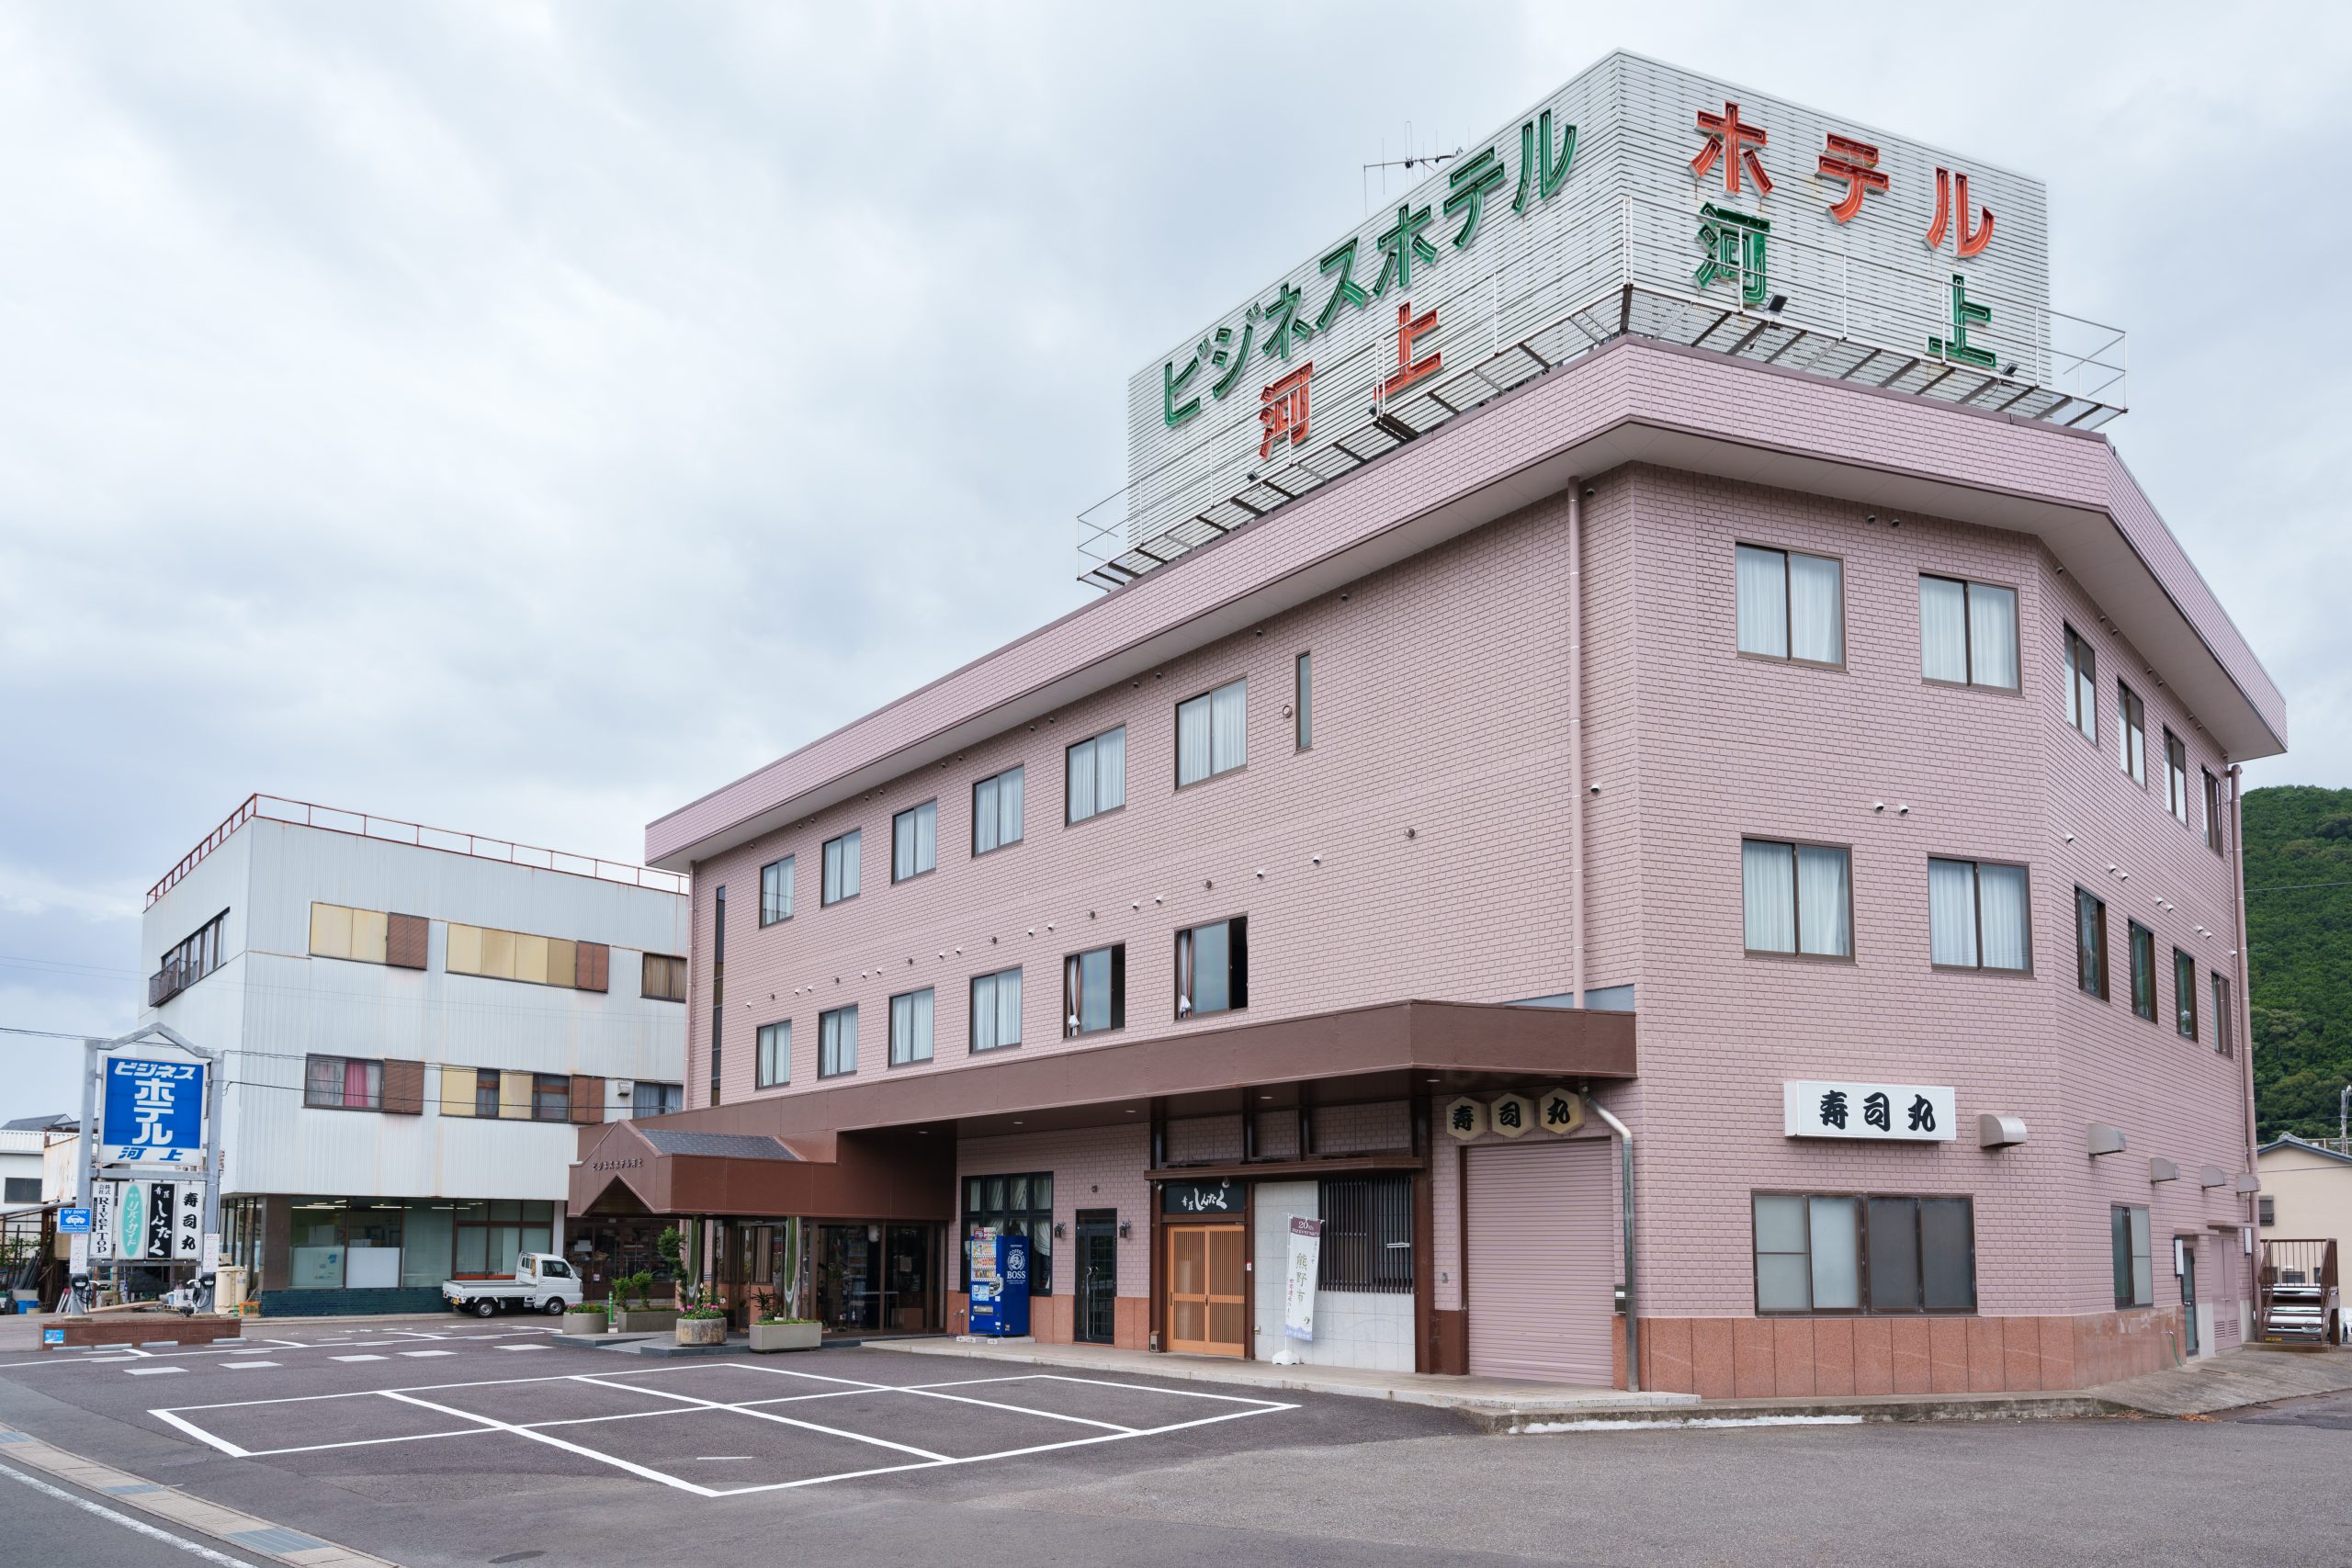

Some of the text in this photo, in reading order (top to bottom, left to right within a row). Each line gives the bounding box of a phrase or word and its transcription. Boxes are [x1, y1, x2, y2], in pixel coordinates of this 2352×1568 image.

[1687, 100, 1995, 258] ホテル
[1164, 108, 1577, 428] ビジネスホテル
[1692, 201, 1996, 367] 河上
[1259, 301, 1443, 460] 河上
[114, 1061, 196, 1080] ビジネス
[131, 1077, 175, 1145] ホテル
[1453, 1097, 1571, 1132] 寿司丸
[1819, 1089, 1936, 1133] 寿司丸
[118, 1147, 183, 1162] 河上
[97, 1197, 109, 1231] River
[182, 1192, 198, 1250] 寿司丸
[1194, 1188, 1227, 1211] しんたく
[149, 1200, 172, 1257] しんたく
[1007, 1270, 1025, 1280] BOSS
[1296, 1252, 1307, 1304] 熊野市
